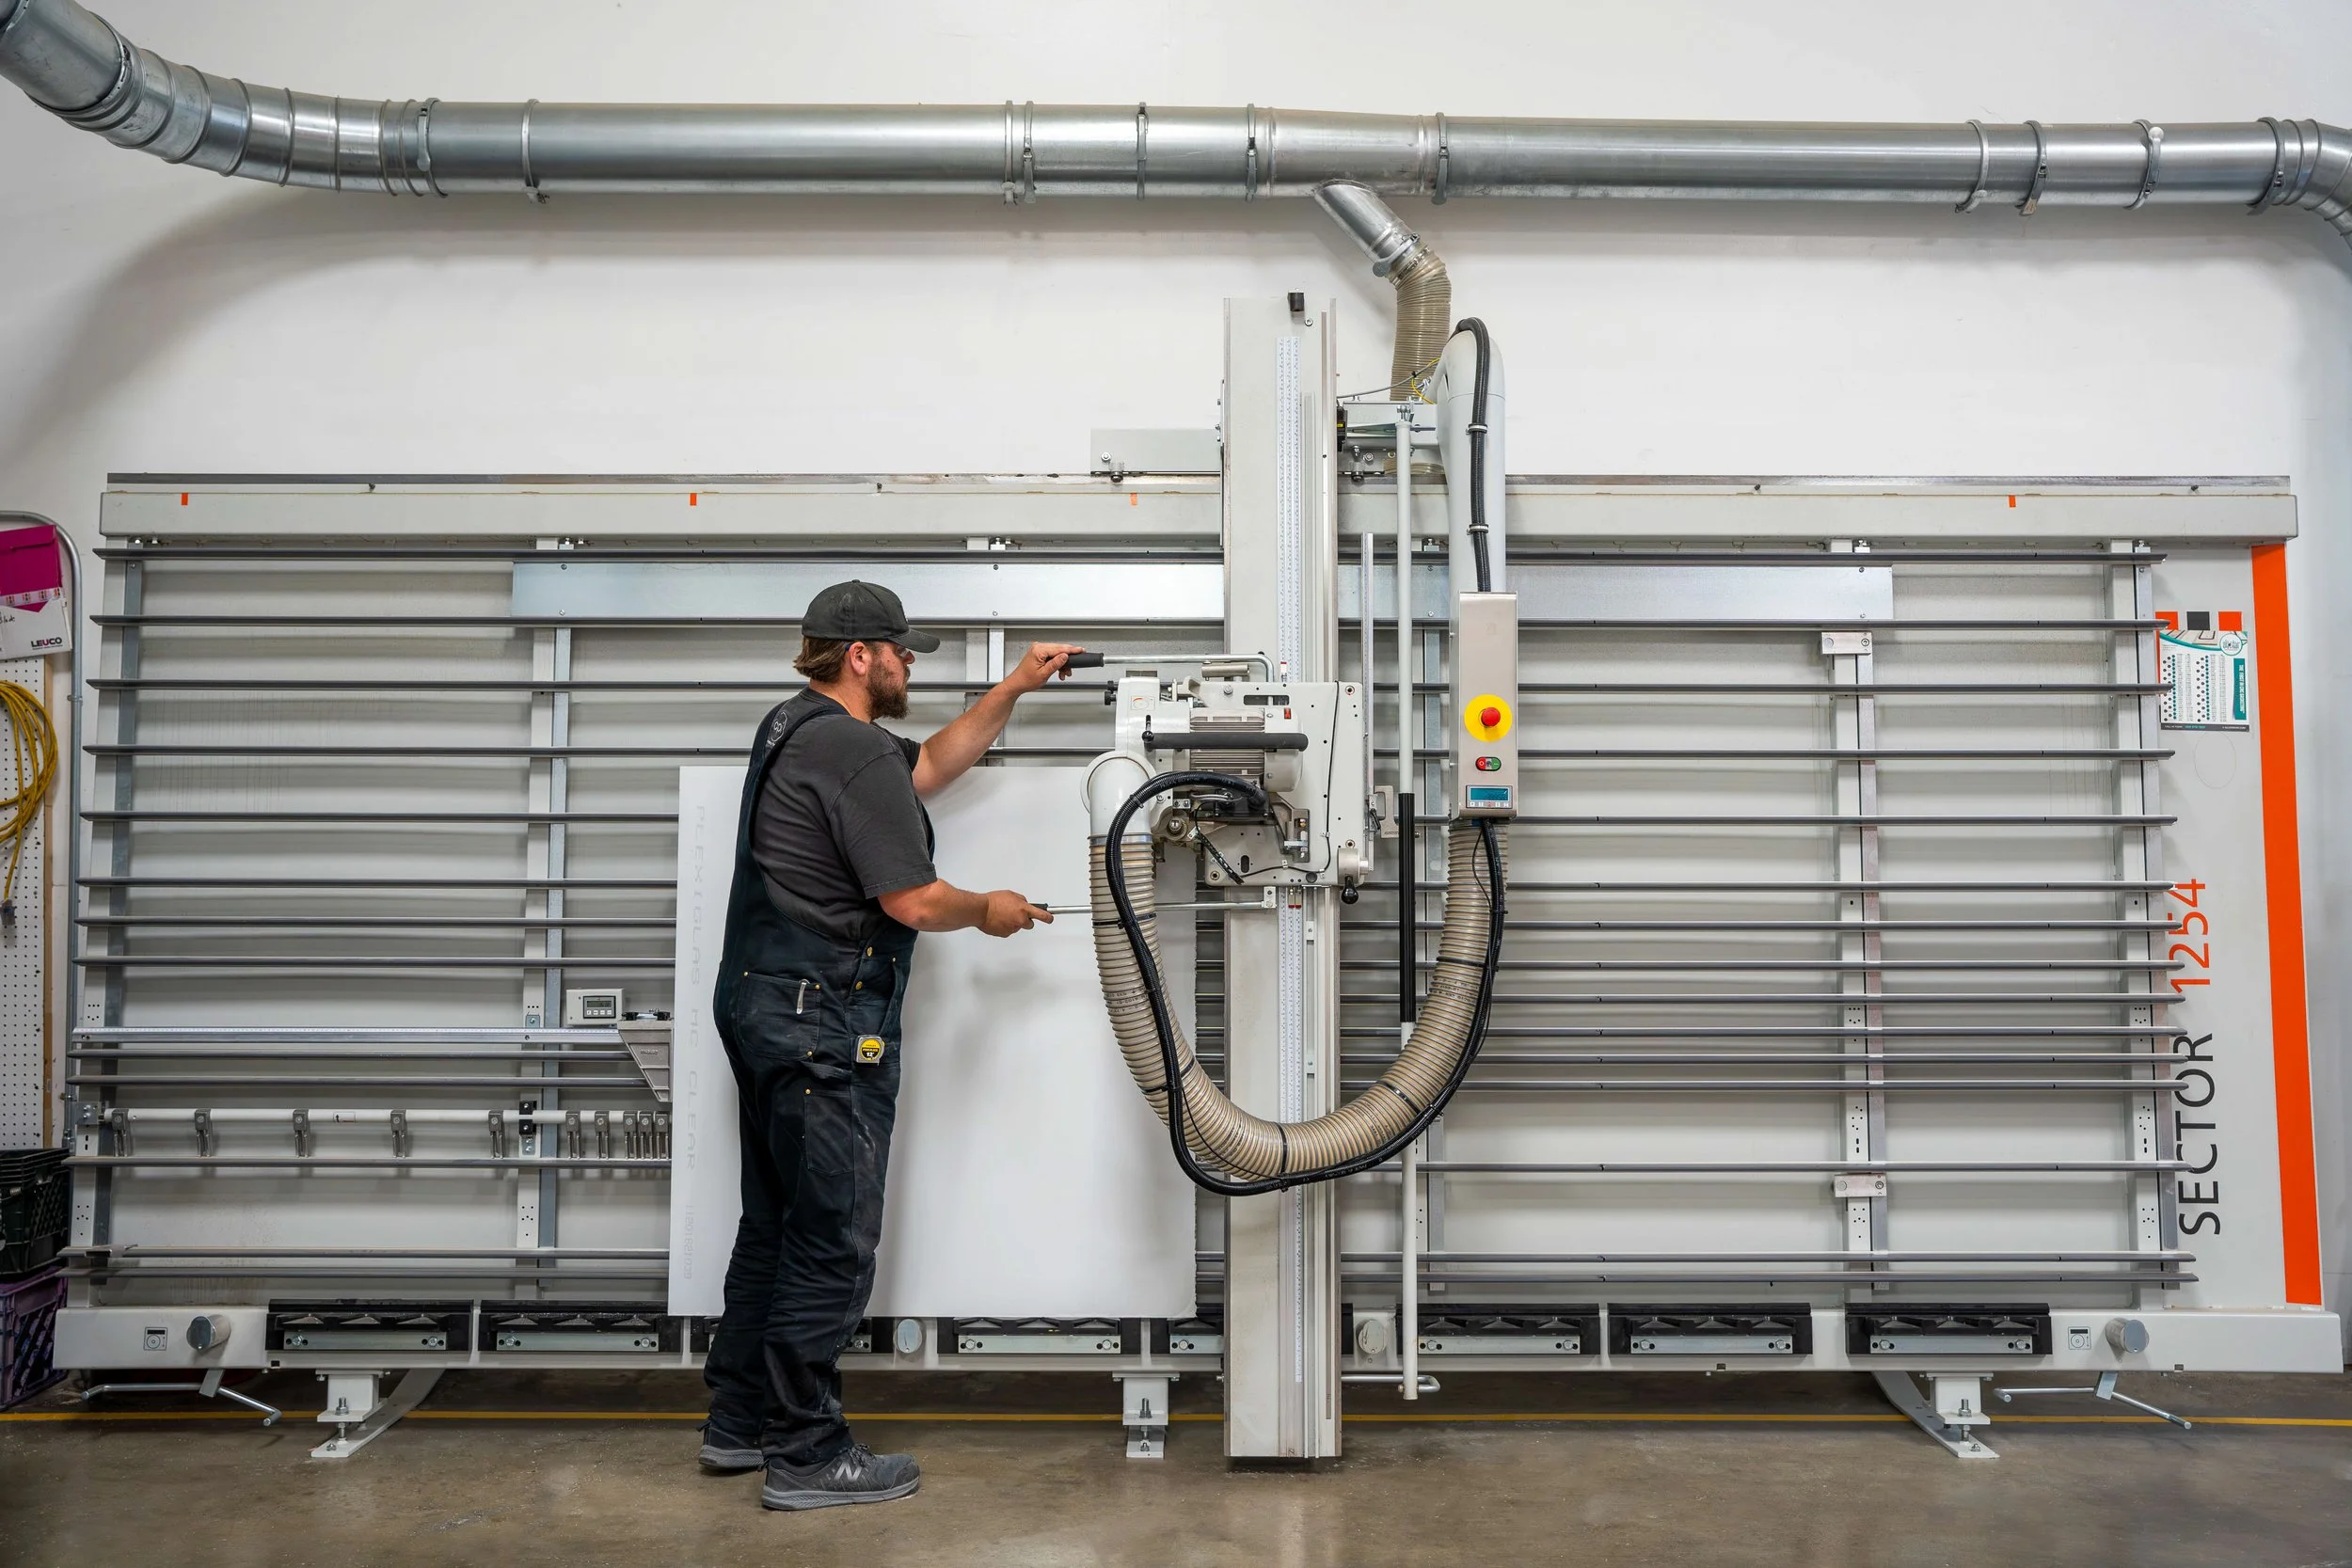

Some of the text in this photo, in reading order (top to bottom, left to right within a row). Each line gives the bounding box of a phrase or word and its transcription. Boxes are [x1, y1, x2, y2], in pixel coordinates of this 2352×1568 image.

[31, 637, 63, 647] LEUCO
[691, 805, 706, 986] PLEXIGLAS
[691, 1007, 701, 1048] MC
[2167, 878, 2220, 1235] SECTOR 1254
[686, 1069, 698, 1170] CLEAR
